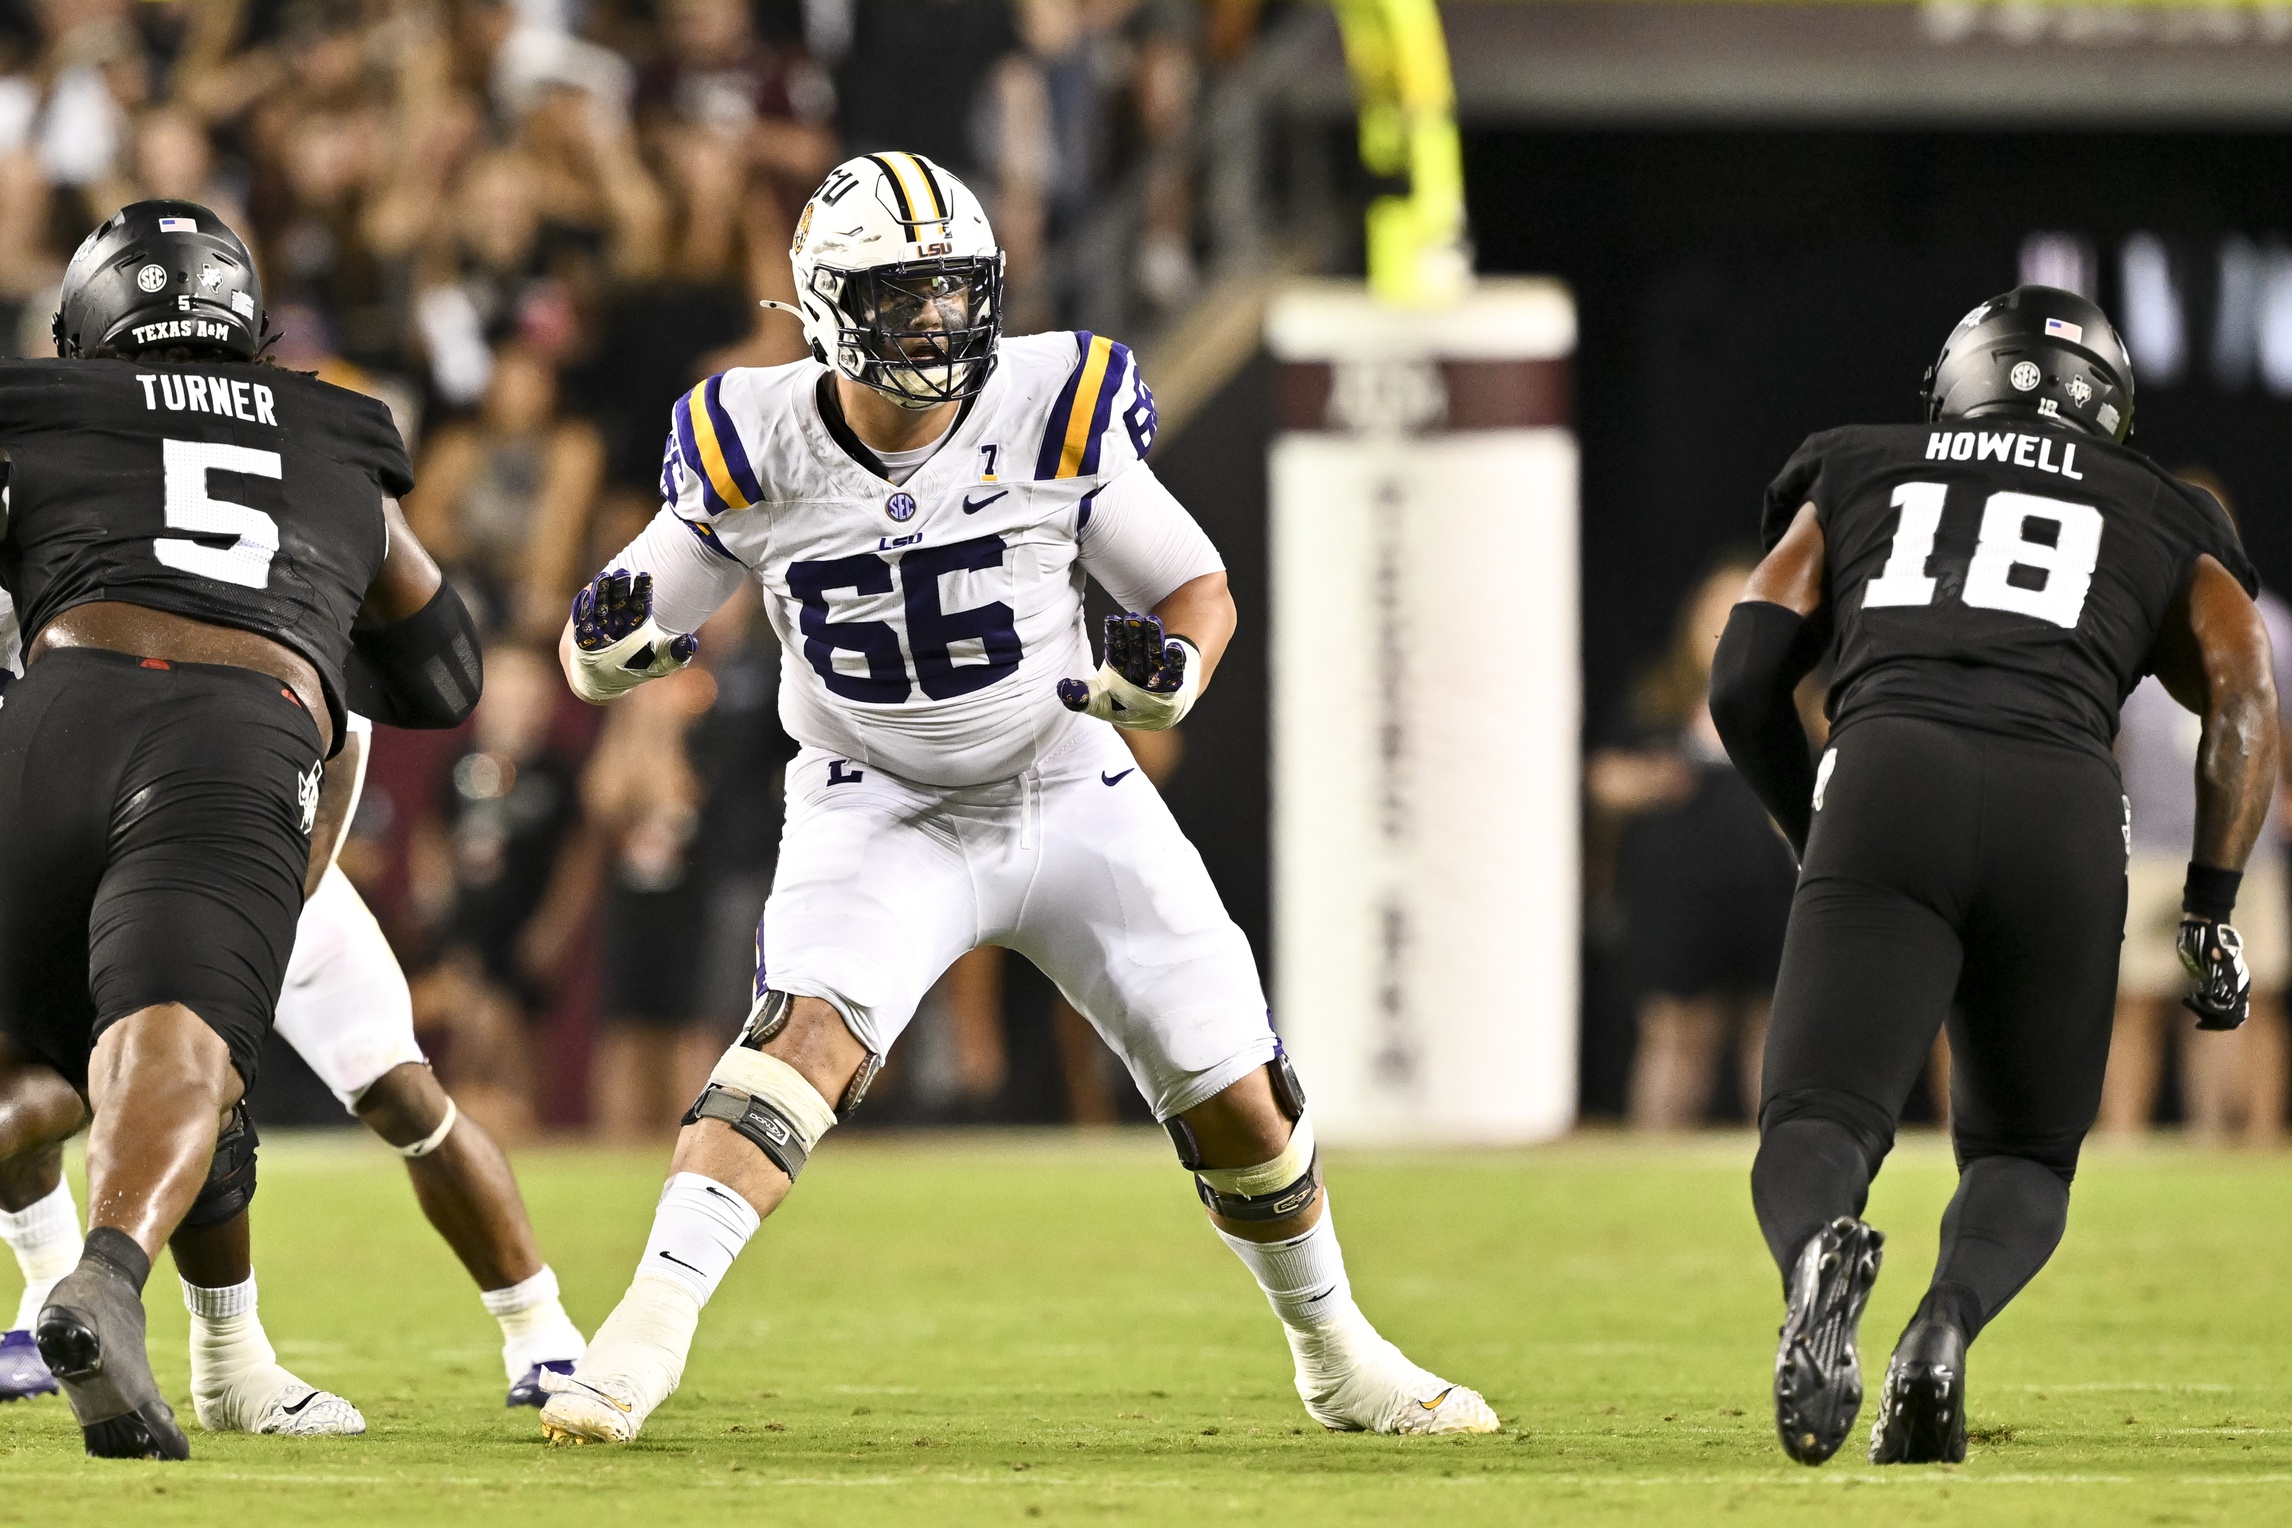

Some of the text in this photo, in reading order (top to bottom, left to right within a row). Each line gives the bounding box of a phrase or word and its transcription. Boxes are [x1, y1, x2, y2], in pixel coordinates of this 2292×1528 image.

[917, 242, 953, 259] LSU
[139, 265, 166, 291] SEC
[178, 295, 191, 311] 5
[132, 320, 230, 344] TEXAS A&M
[2013, 362, 2039, 390] SEC
[136, 374, 278, 427] TURNER
[2038, 397, 2060, 419] 18
[981, 444, 998, 476] 7
[1925, 432, 2083, 480] HOWELL
[153, 438, 282, 589] 5
[888, 494, 915, 520] SEC
[879, 532, 923, 551] LSU
[1861, 481, 2104, 629] 18
[784, 534, 1023, 704] 66
